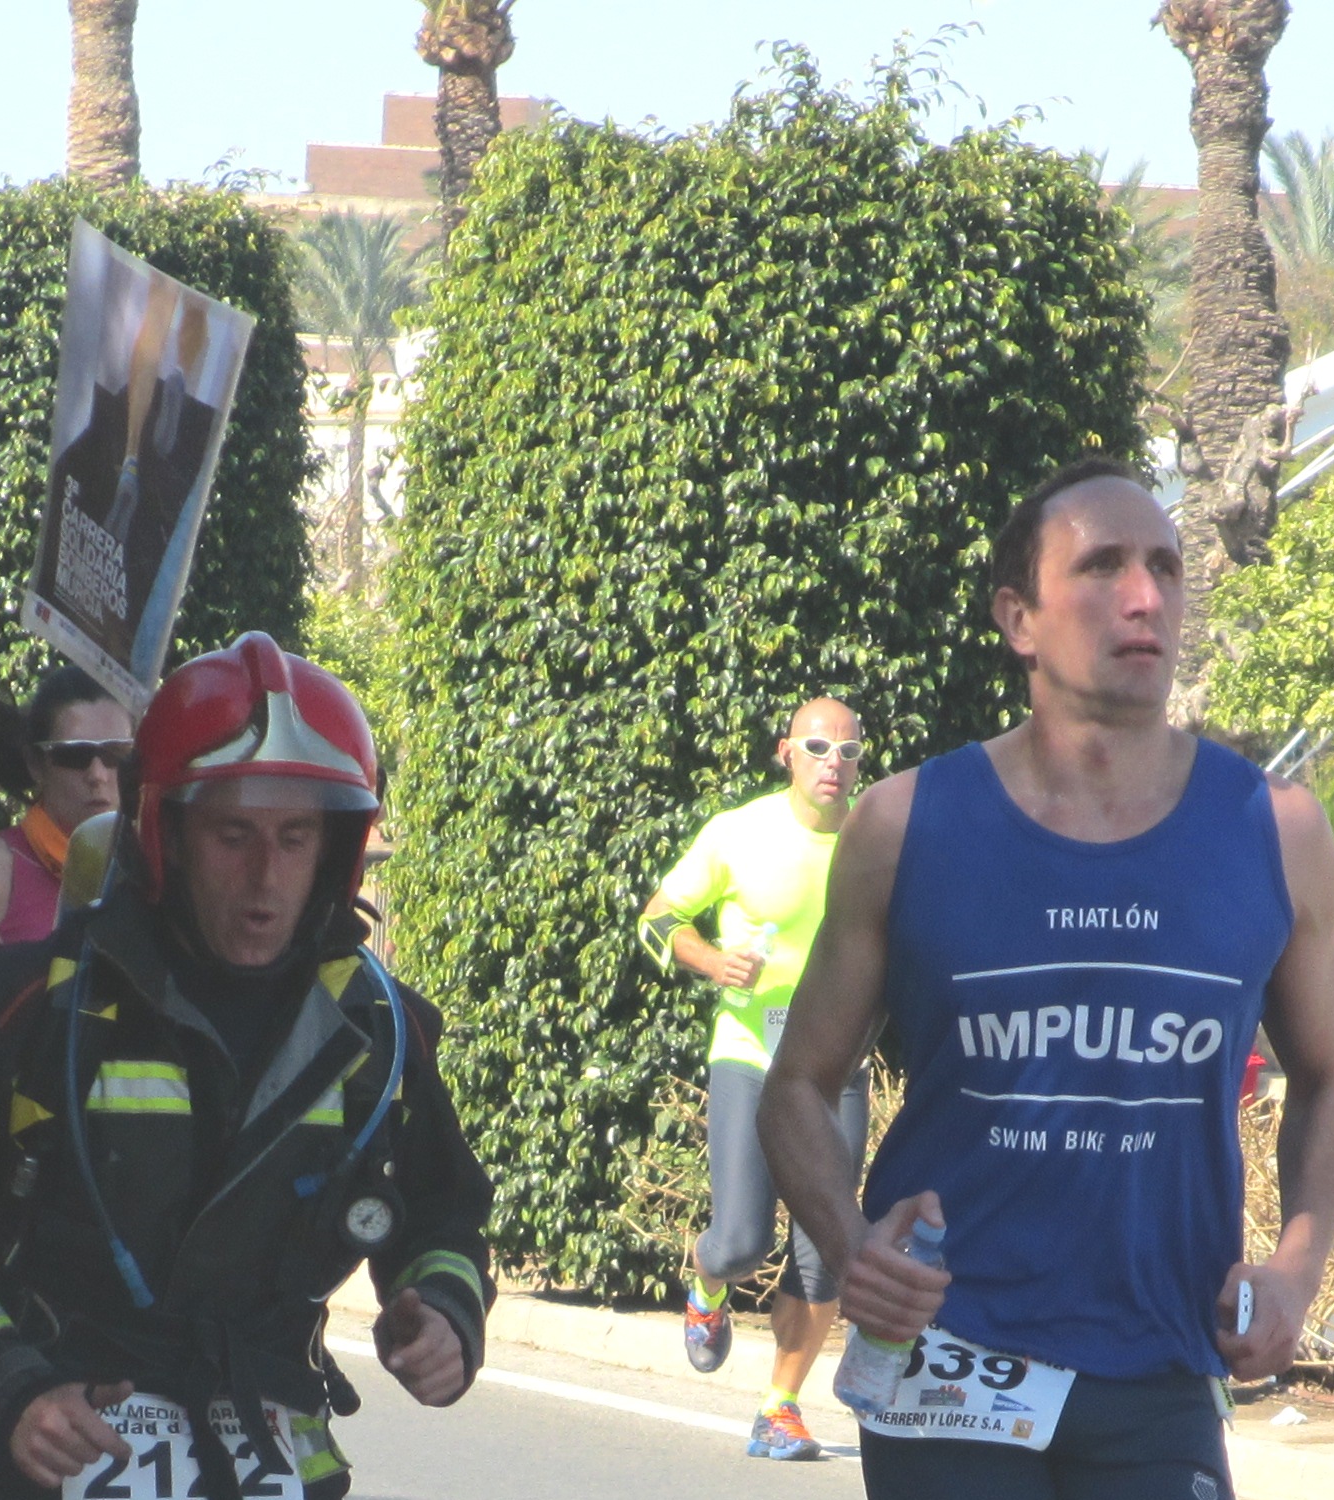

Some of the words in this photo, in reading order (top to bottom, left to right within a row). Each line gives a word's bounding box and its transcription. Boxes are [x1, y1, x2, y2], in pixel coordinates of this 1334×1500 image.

[60, 518, 127, 596] SOLIDARIA
[62, 497, 124, 568] CARRERA
[55, 562, 104, 625] MURCIA
[58, 543, 128, 620] BOMBEROS
[1046, 903, 1160, 930] TRIATLÓN
[958, 1004, 1223, 1064] IMPULSO
[989, 1125, 1047, 1151] SWIM
[1065, 1131, 1105, 1153] BIKE
[1121, 1131, 1156, 1153] RUN
[874, 1411, 927, 1427] HERRERO
[929, 1414, 936, 1426] Y
[939, 1411, 977, 1428] LÓPEZ
[981, 1417, 1006, 1432] S.A.
